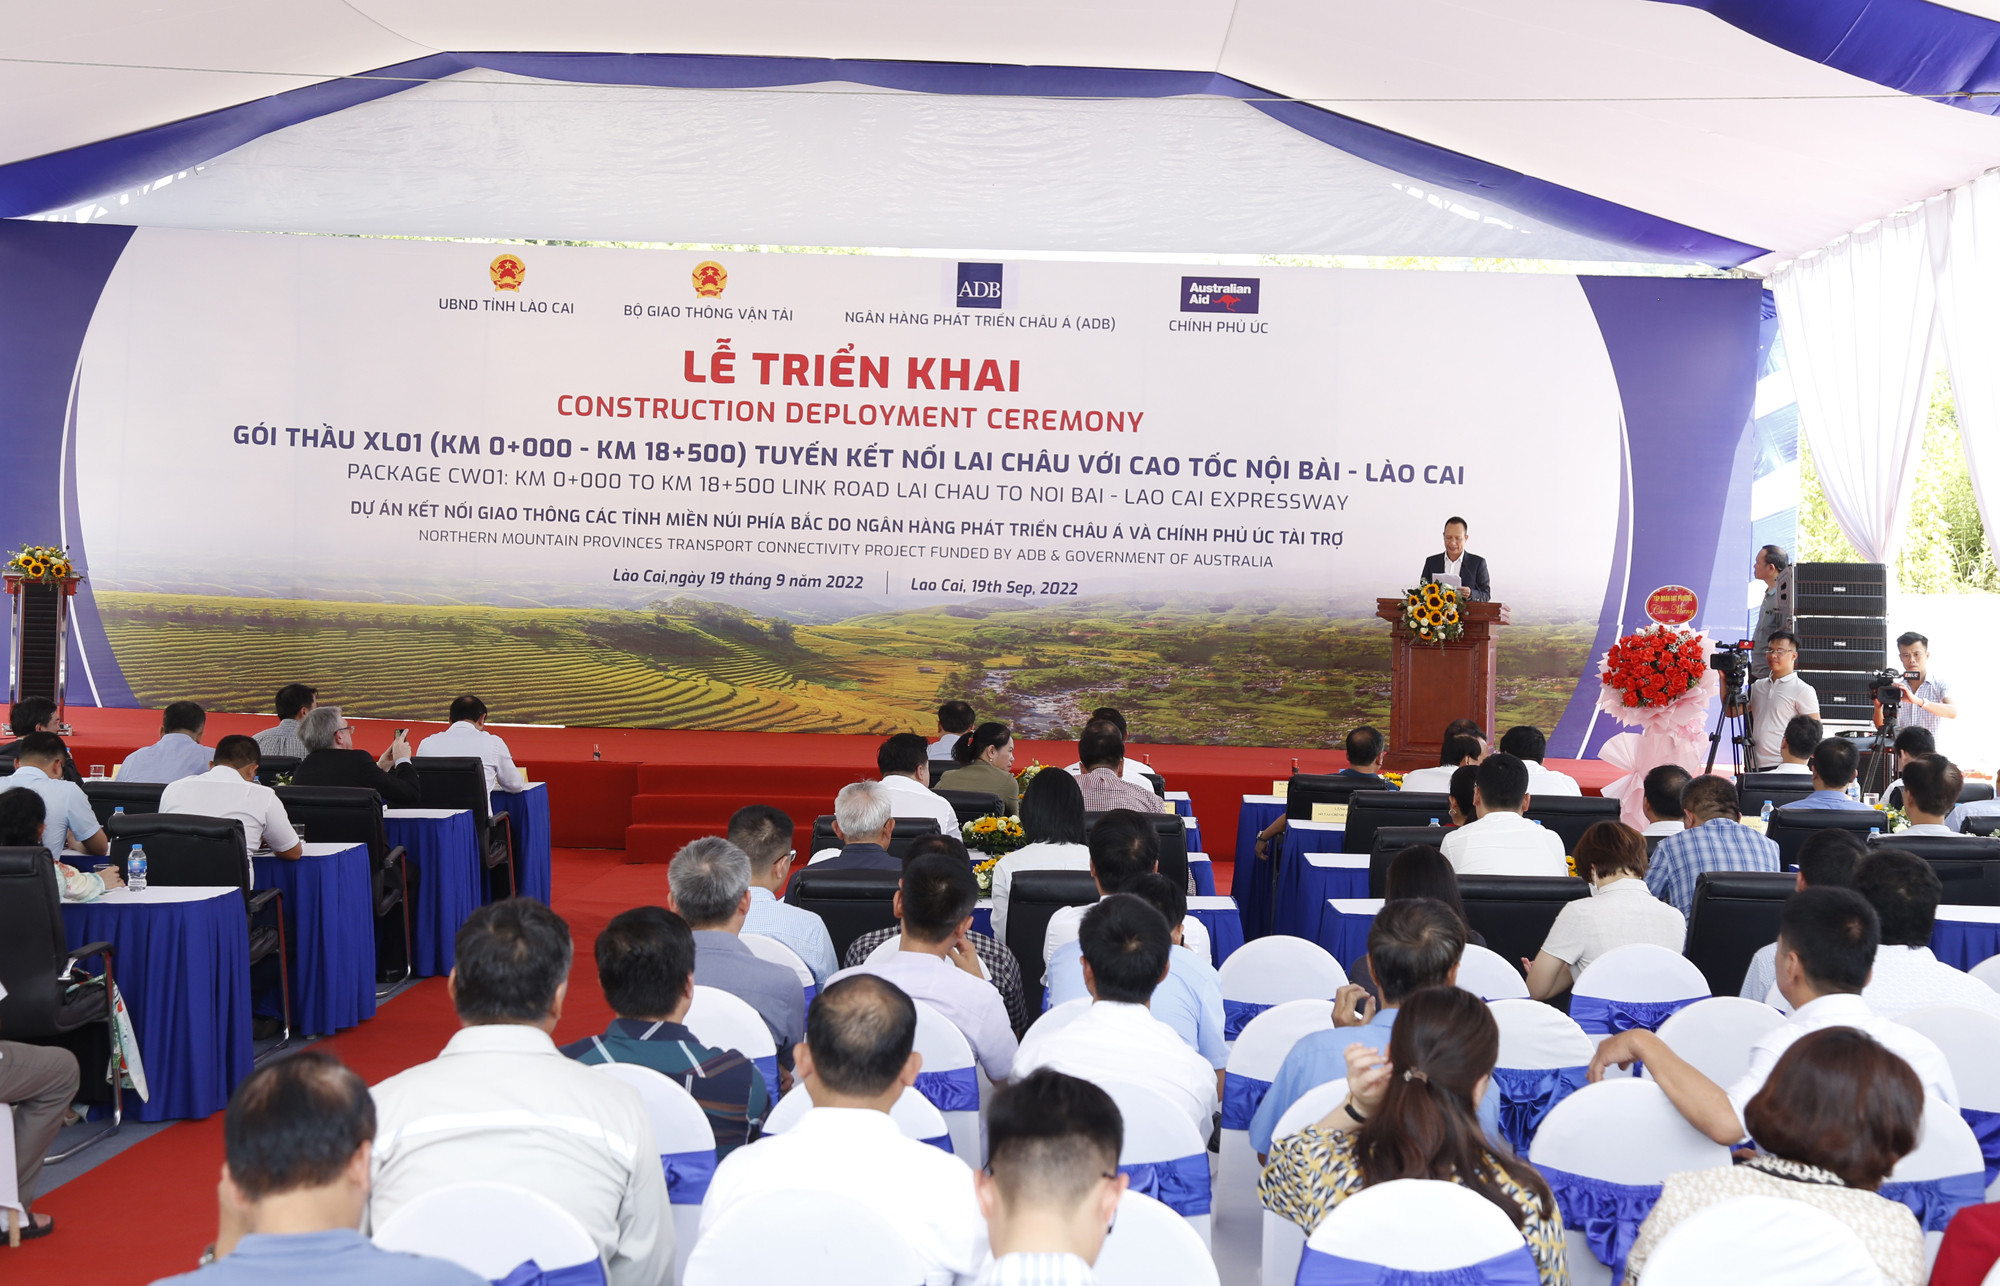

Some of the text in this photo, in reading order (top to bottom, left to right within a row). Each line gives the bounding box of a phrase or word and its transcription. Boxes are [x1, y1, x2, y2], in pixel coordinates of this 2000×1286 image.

[958, 281, 1000, 298] ADB
[1189, 282, 1252, 294] Australian
[439, 297, 574, 314] UBND TỈNH LÀO CAI
[1189, 294, 1210, 305] Aid
[624, 302, 793, 323] BỘ GIAO THÔNG VẬN TẢI
[845, 309, 1115, 332] NGÂN HÀNG PHÁT TRIỂN CHÂU Á (ADB)
[1169, 318, 1268, 334] CHÍNH PHỦ ÚC
[684, 338, 1020, 392] LỄ TRIỂN KHAI
[557, 394, 1144, 433] CONSTRUCTION DEPLOYMENT CEREMONY
[233, 421, 277, 446] GÓI
[285, 423, 355, 449] THẦU
[363, 431, 422, 453] XL01
[430, 431, 480, 458] (KM
[489, 436, 572, 458] 0+000
[597, 440, 636, 460] KM
[645, 441, 746, 468] 18+500)
[755, 440, 838, 467] TUYẾN
[846, 442, 894, 468] KẾT
[902, 444, 945, 470] NỐI
[954, 451, 992, 471] LAI
[1001, 449, 1070, 473] CHÂU
[1078, 450, 1121, 475] VỚI
[1129, 456, 1180, 476] CAO
[1188, 452, 1237, 478] TỐC
[1246, 455, 1289, 485] NỘI
[1299, 457, 1340, 481] BÀI
[1366, 459, 1415, 483] LÀO
[1424, 465, 1464, 485] CAI
[348, 463, 441, 483] PACKAGE
[448, 467, 508, 485] CW01:
[516, 470, 545, 487] KM
[553, 471, 621, 489] 0+000
[628, 474, 654, 490] TO
[662, 475, 692, 491] KM
[699, 476, 775, 494] 18+500
[783, 479, 826, 496] LINK
[834, 480, 889, 497] ROAD
[897, 482, 927, 498] LAI
[935, 483, 989, 500] CHAU
[996, 485, 1022, 501] TO
[1030, 486, 1064, 503] NOI
[1072, 487, 1103, 504] BAI
[1125, 488, 1164, 505] LAO
[1172, 490, 1203, 506] CAI
[1211, 491, 1349, 511] EXPRESSWAY
[351, 499, 1343, 550] DỰ ÁN KẾT NỐI GIAO THÔNG CÁC TỈNH MIỀN NÚI PHÍA BẮC DO NGÂN HÀNG PHÁT TRIỂN CHÂU Á VÀ CHÍNH PHỦ ÚC TÀI TRỢ
[419, 529, 1273, 568] NORTHERN MOUNTAIN PROVINCES TRANSPORT CONNECTIVITY PROJECT FUNDED BY ADB & GOVERNMENT OF AUSTRALIA
[613, 568, 639, 582] Lào
[710, 571, 725, 585] 19
[729, 572, 772, 590] tháng
[776, 573, 785, 587] 9
[789, 574, 822, 588] năm
[825, 575, 864, 589] 2022
[911, 577, 1078, 598] Lao Cai, 19th Sep, 2022
